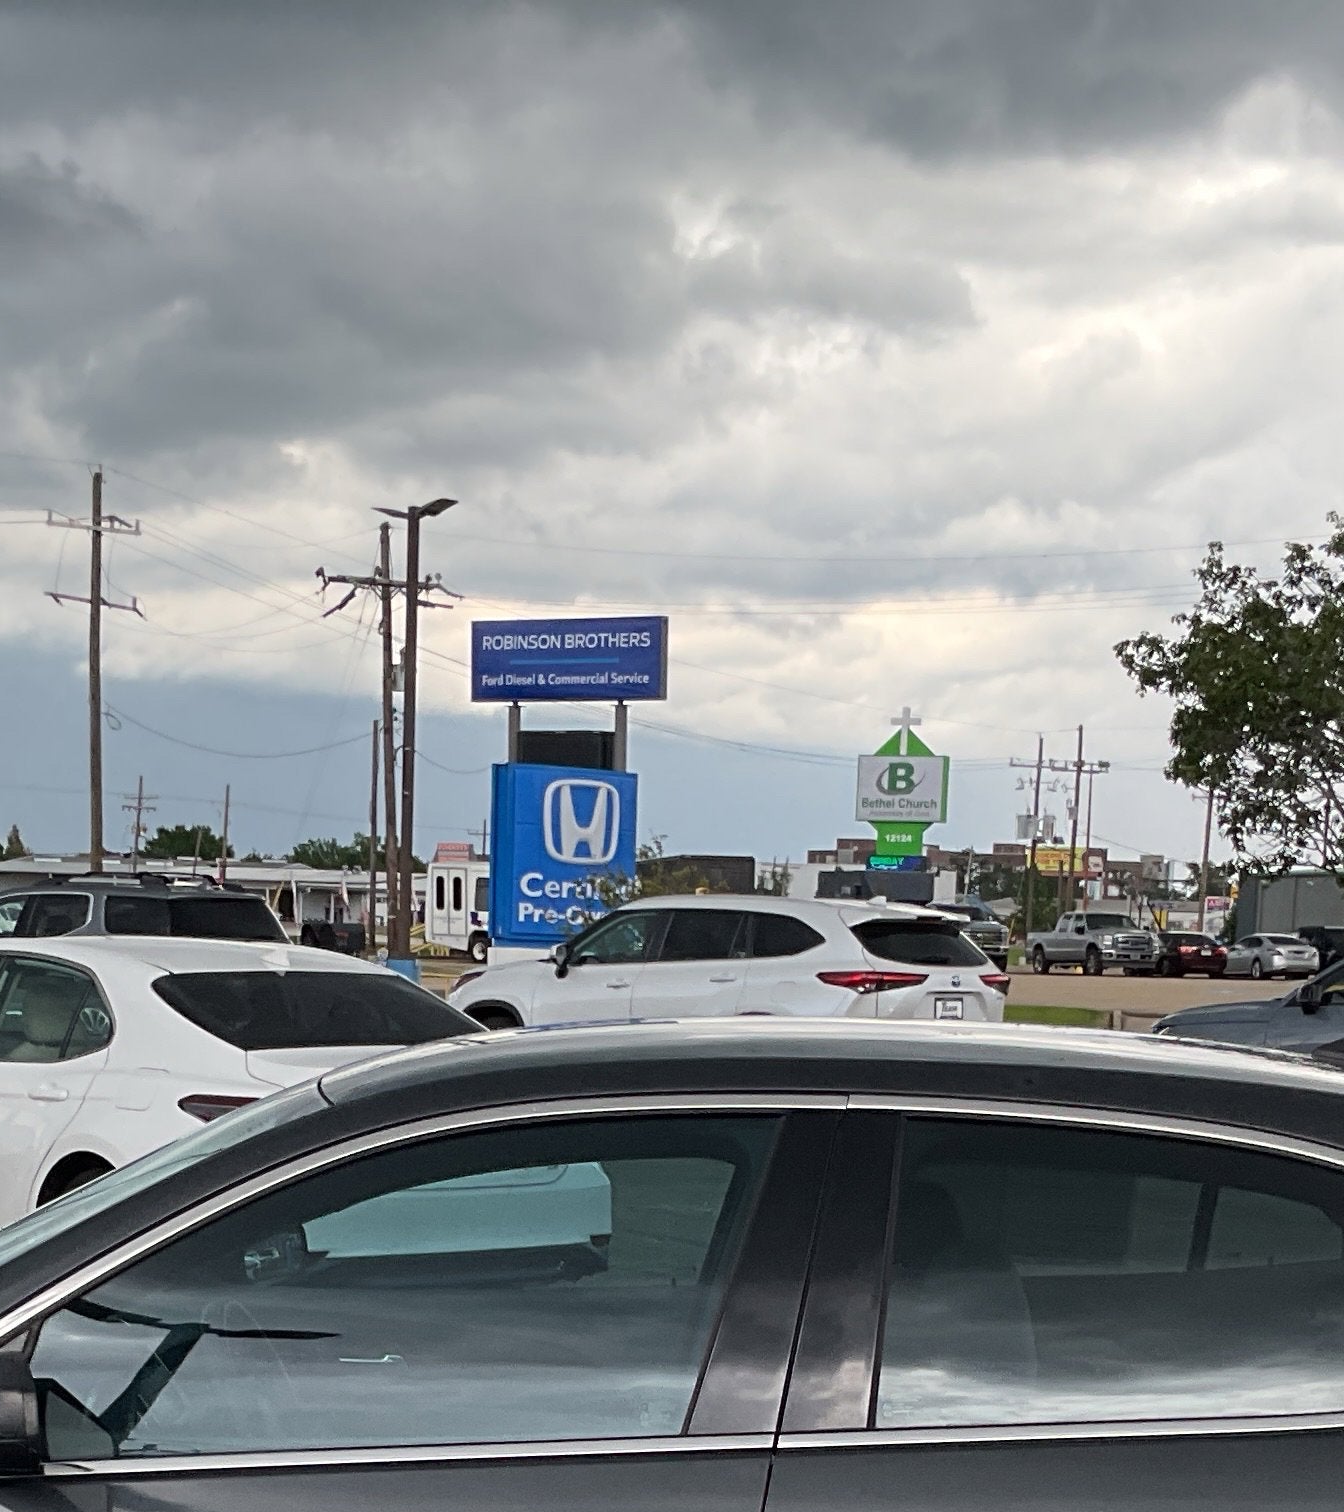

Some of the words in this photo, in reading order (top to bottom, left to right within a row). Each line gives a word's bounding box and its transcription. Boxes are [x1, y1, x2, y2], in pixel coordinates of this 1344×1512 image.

[482, 634, 562, 651] ROBINSON
[564, 632, 652, 649] BROTHERS
[482, 674, 504, 687] Ford
[506, 673, 536, 686] Diesel
[537, 673, 546, 685] &
[548, 672, 609, 685] Commercial
[610, 671, 650, 684] Service
[862, 798, 895, 809] Bethel
[898, 798, 938, 809] Church
